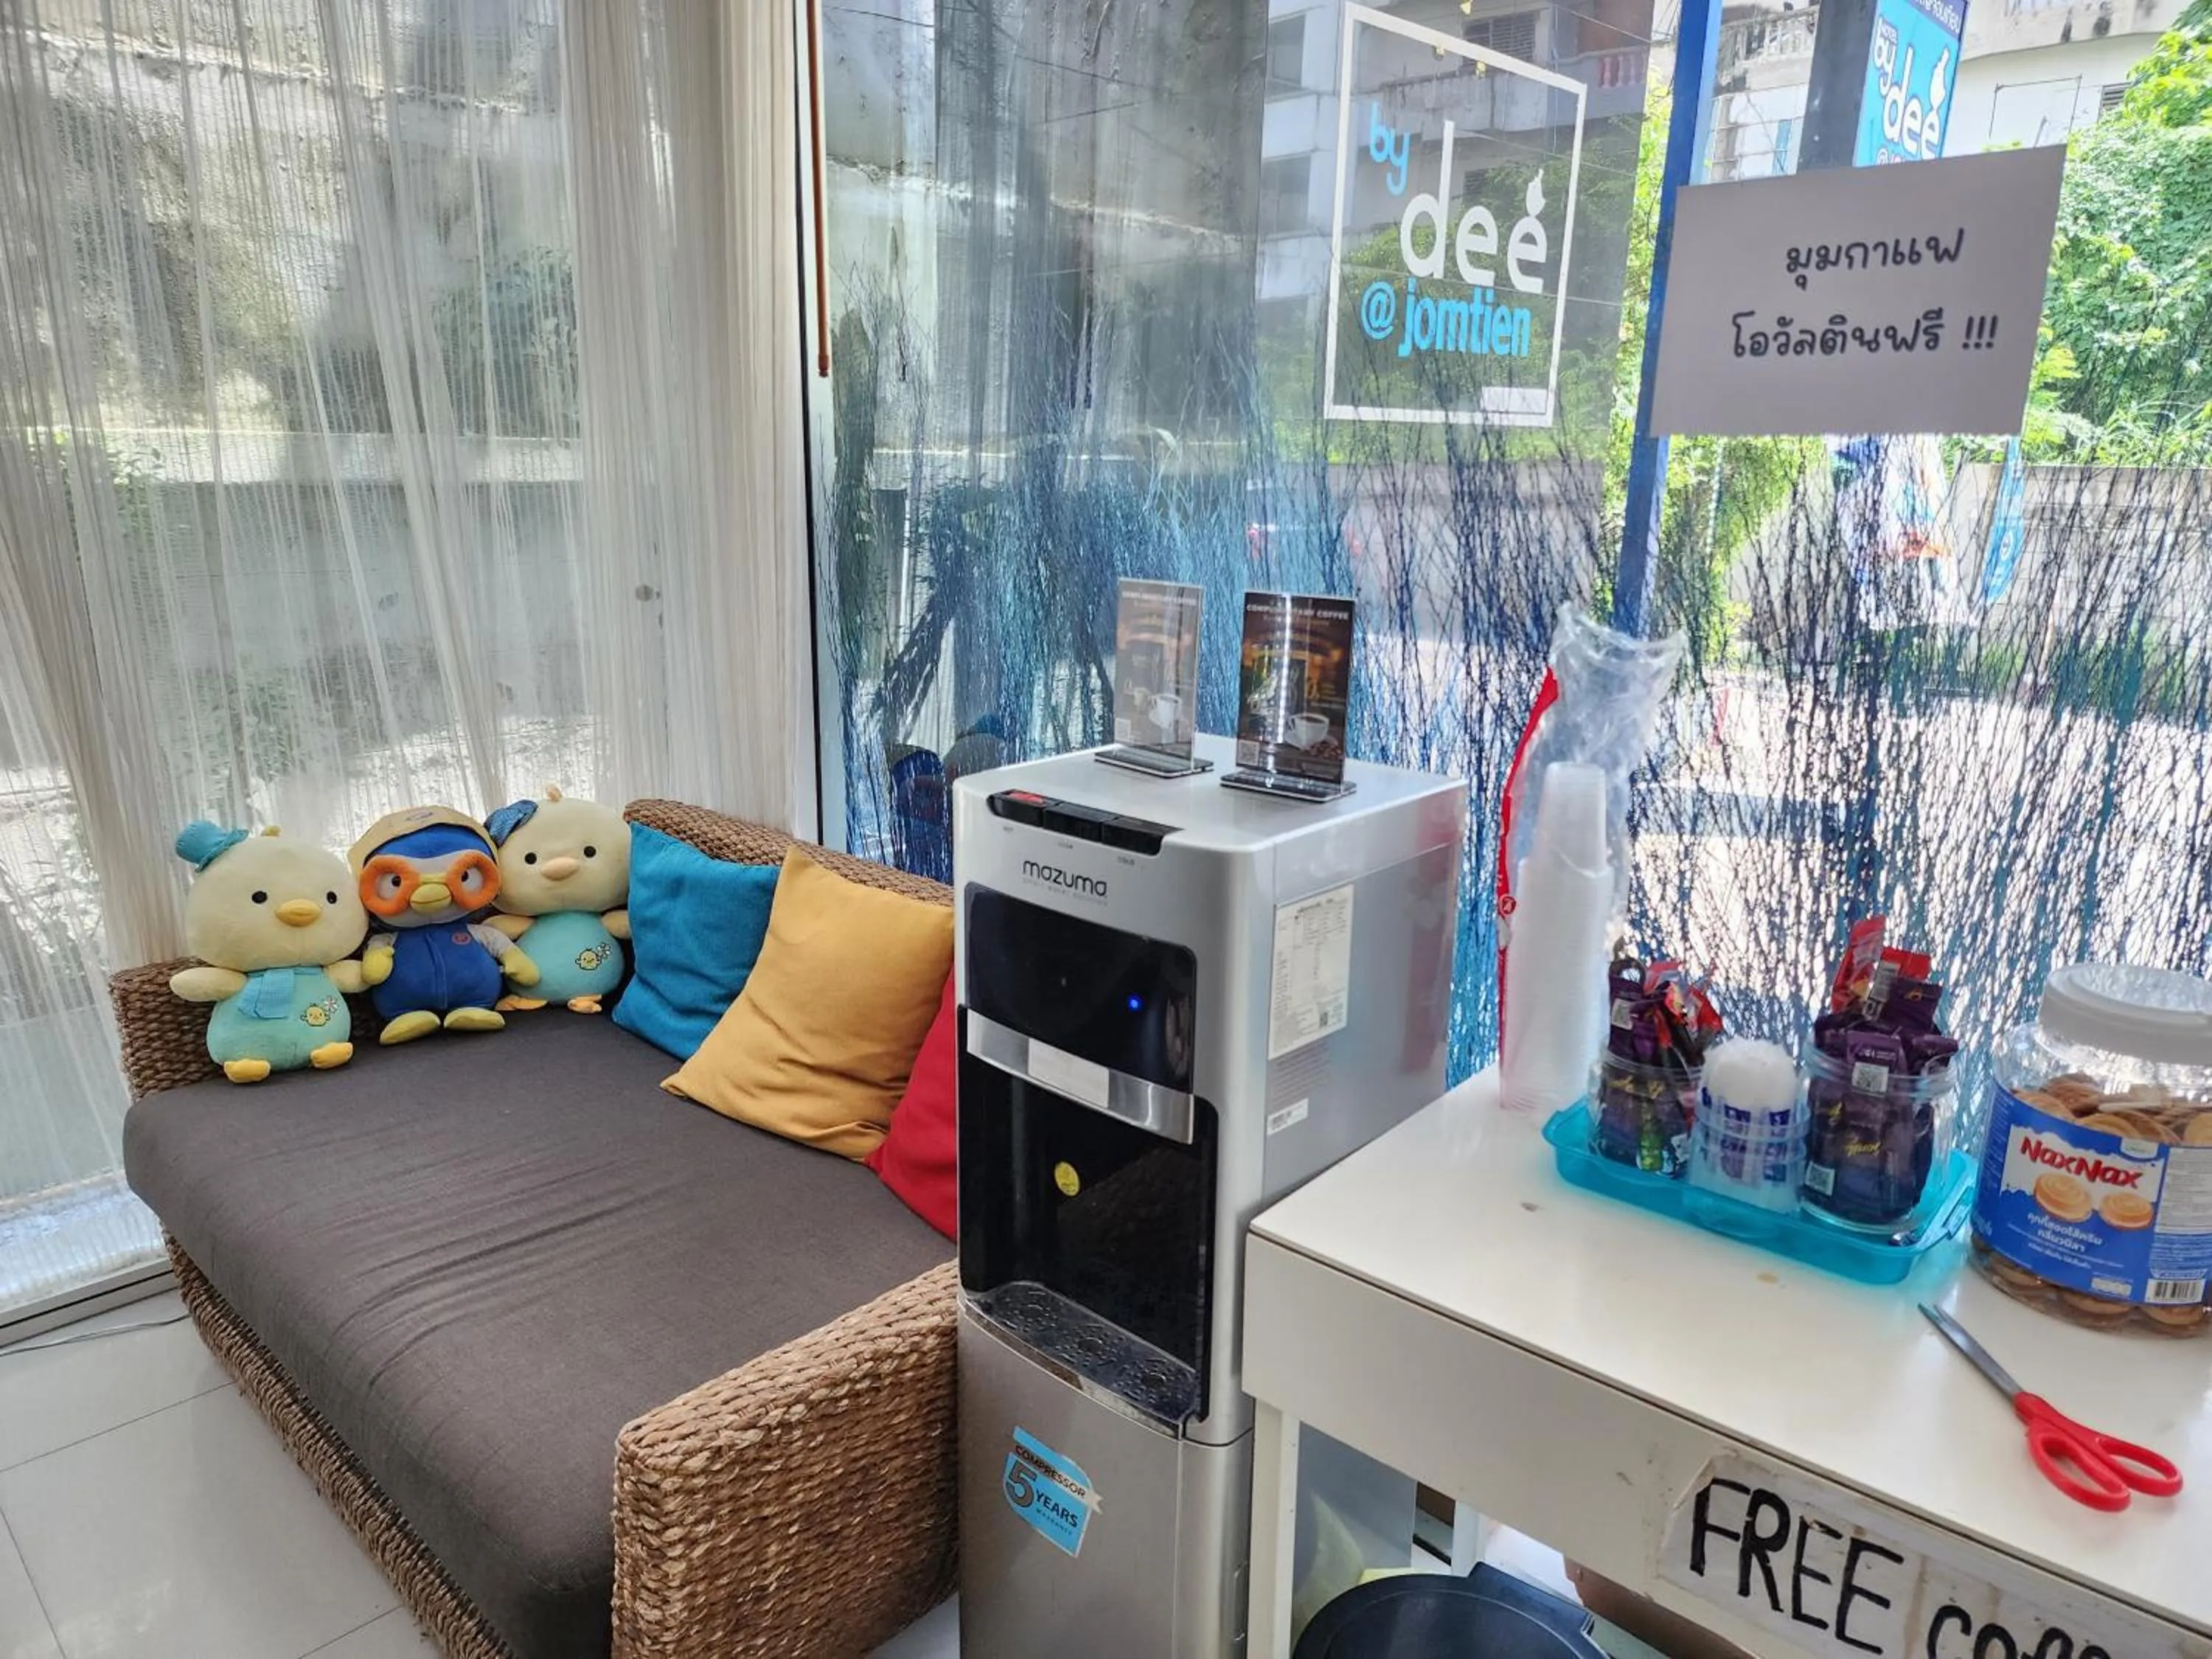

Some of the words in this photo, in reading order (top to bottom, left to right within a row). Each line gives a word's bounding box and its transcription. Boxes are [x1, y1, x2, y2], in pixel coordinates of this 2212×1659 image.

[1874, 17, 1896, 97] by
[1884, 46, 1941, 160] dee
[1369, 101, 1411, 195] by
[1401, 119, 1548, 294] dee
[1786, 227, 1965, 291] มุมกาแฟ
[1731, 307, 1946, 358] โอวัลตินฟรี
[1316, 608, 1349, 620] COFFEE
[1023, 860, 1107, 897] mazuma
[1008, 1460, 1037, 1508] 5
[1036, 1489, 1079, 1528] YEARS
[1015, 1444, 1086, 1499] COMPRESSOR
[1689, 1476, 1904, 1655] FREE
